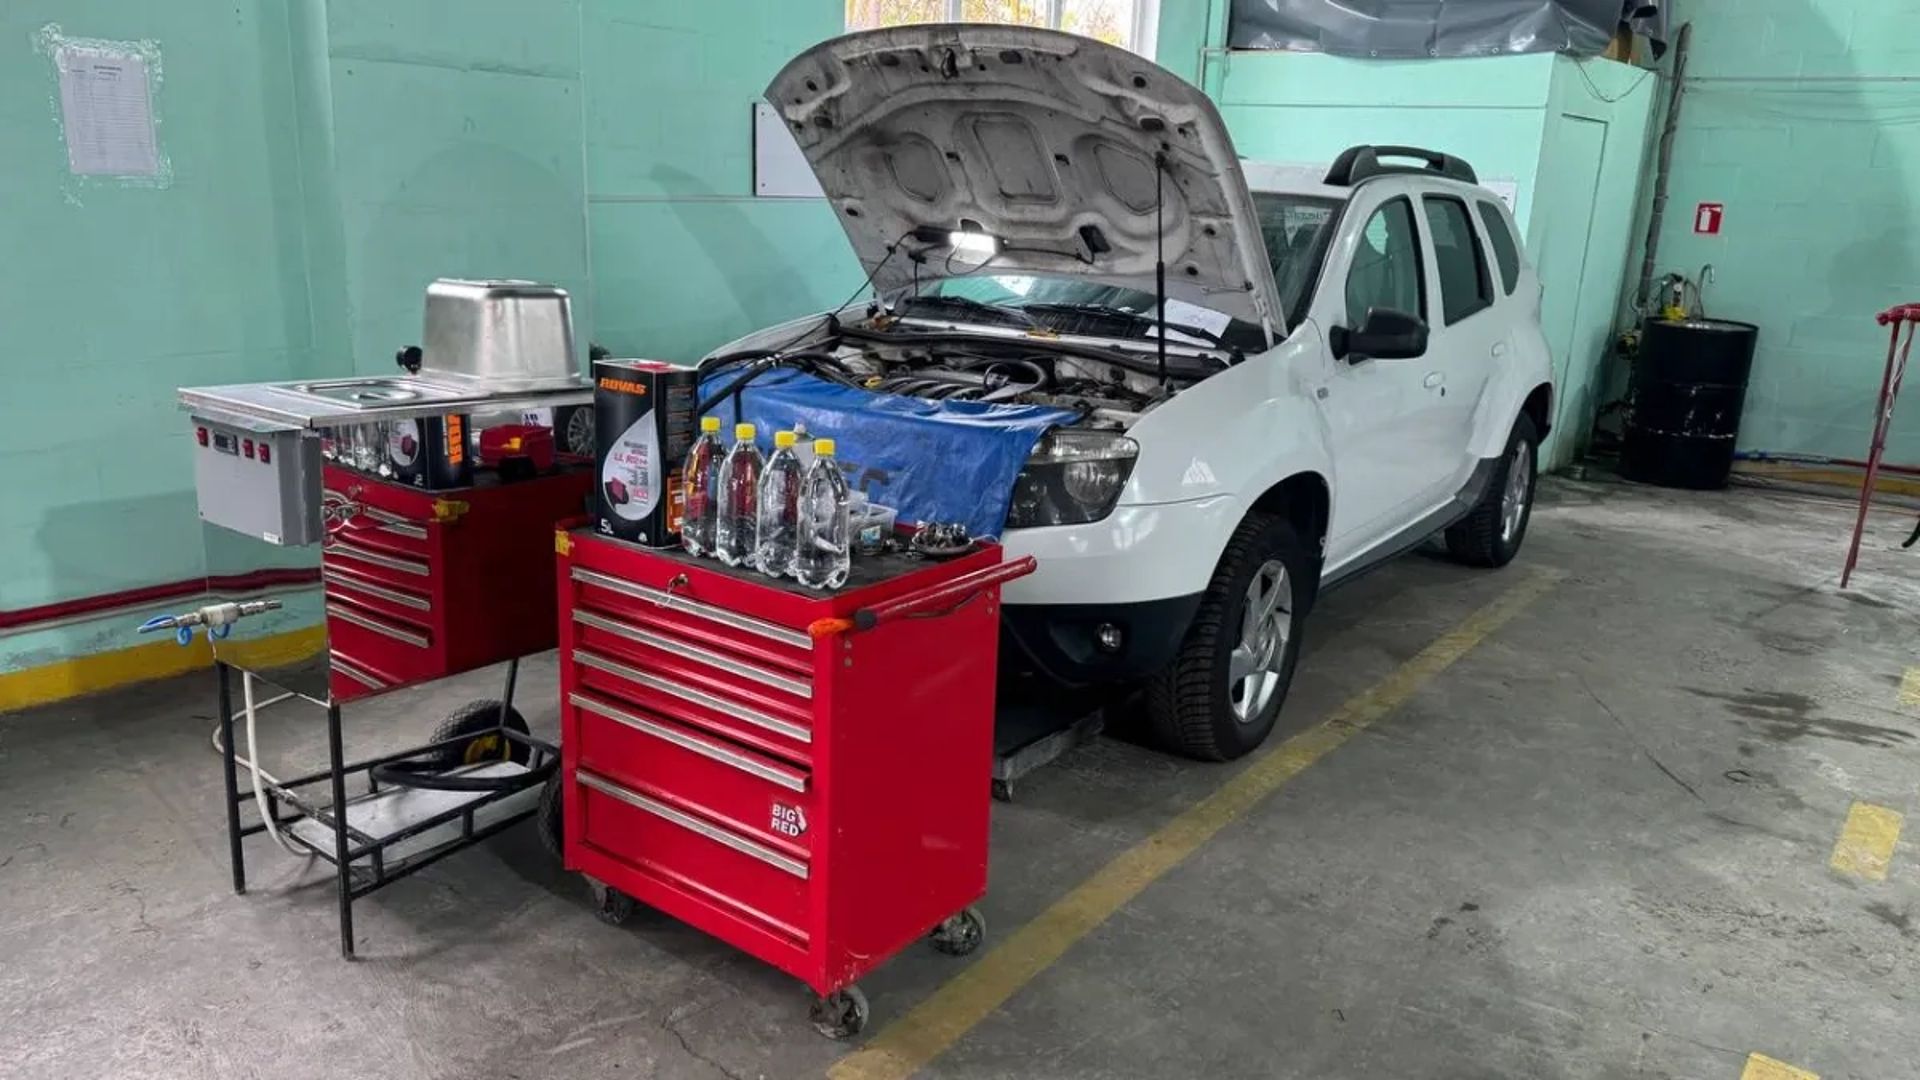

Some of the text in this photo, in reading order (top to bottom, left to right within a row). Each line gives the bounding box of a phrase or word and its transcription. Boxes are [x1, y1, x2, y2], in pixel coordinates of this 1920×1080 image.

[600, 377, 647, 395] ROVAS
[772, 804, 796, 822] BIG
[771, 817, 799, 837] RED
